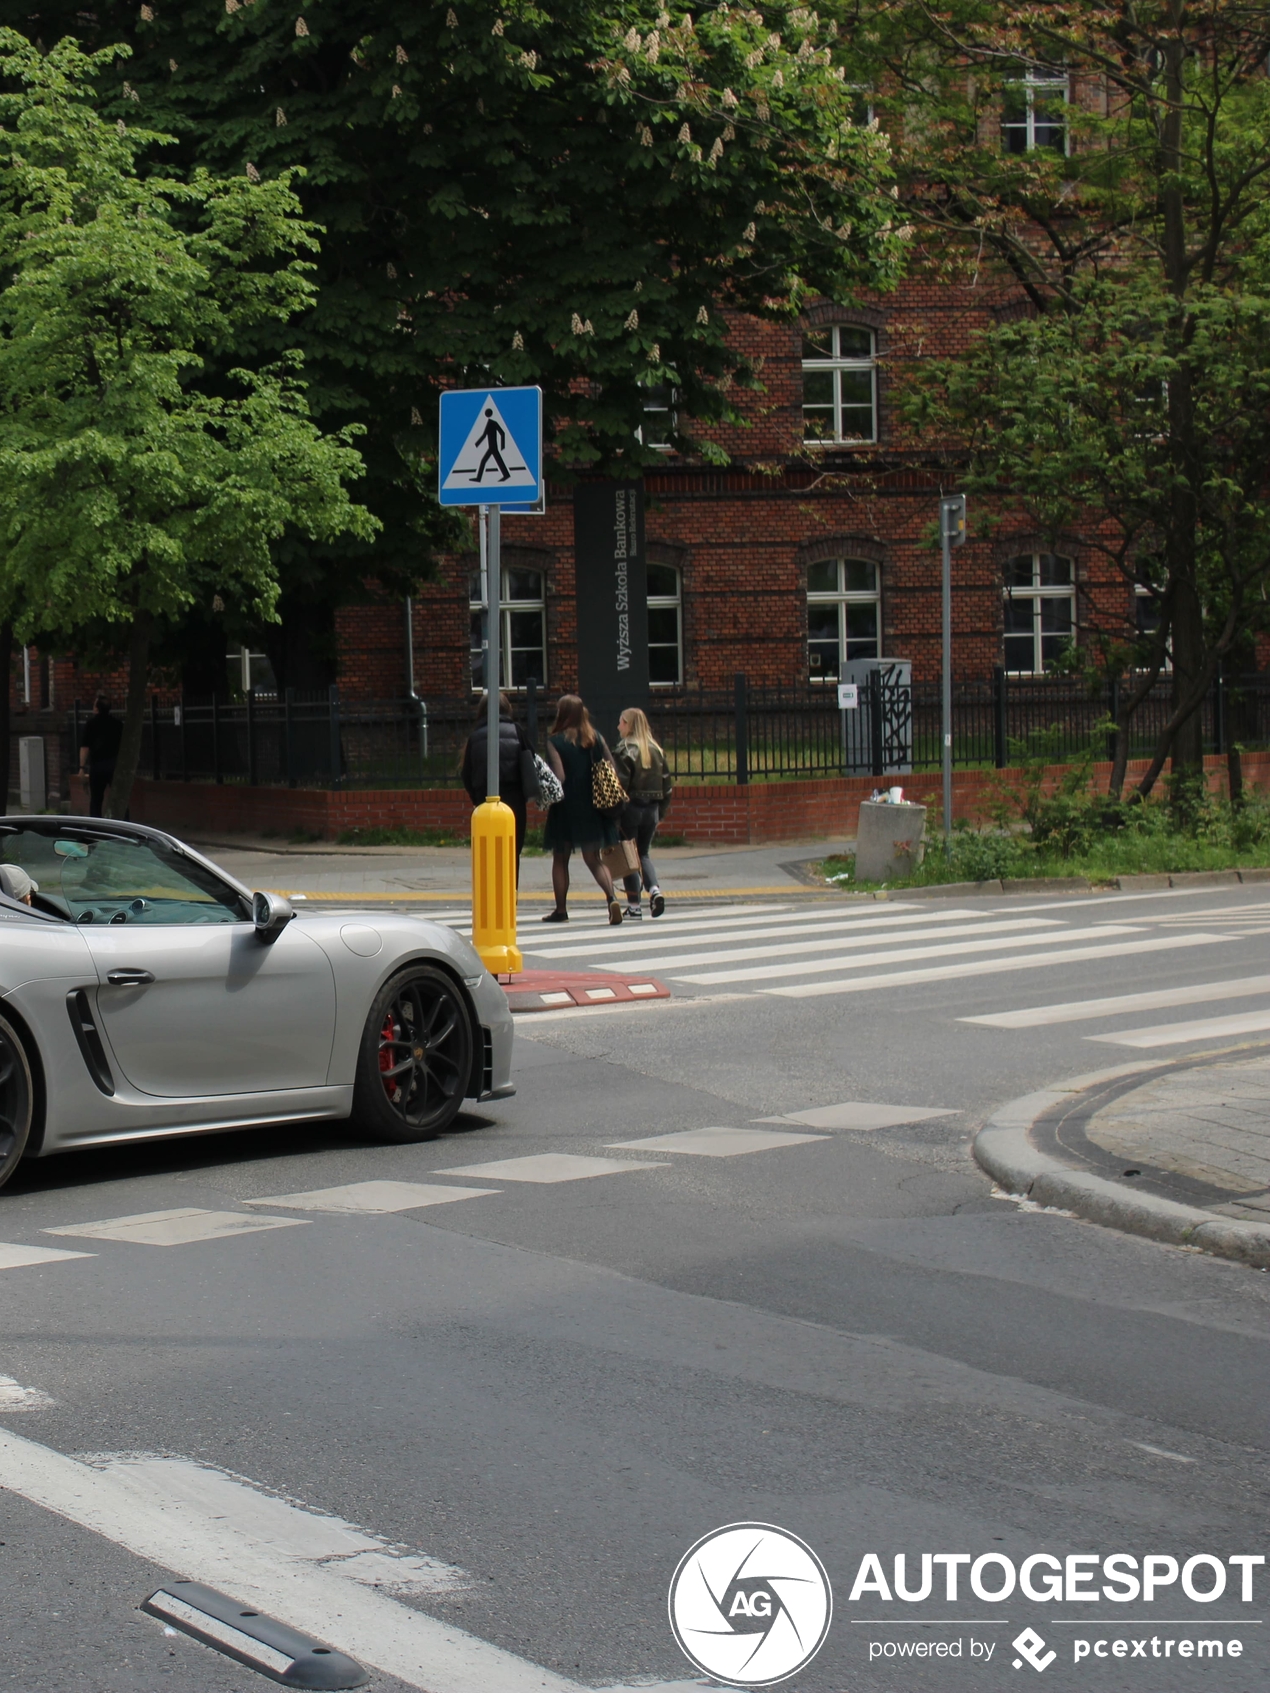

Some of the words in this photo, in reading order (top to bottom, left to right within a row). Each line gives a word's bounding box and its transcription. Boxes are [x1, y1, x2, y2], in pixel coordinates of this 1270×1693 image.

[614, 490, 627, 559] Bankowa
[629, 534, 638, 557] Biuro
[615, 561, 629, 611] Szkoła
[617, 614, 632, 671] Wyższa
